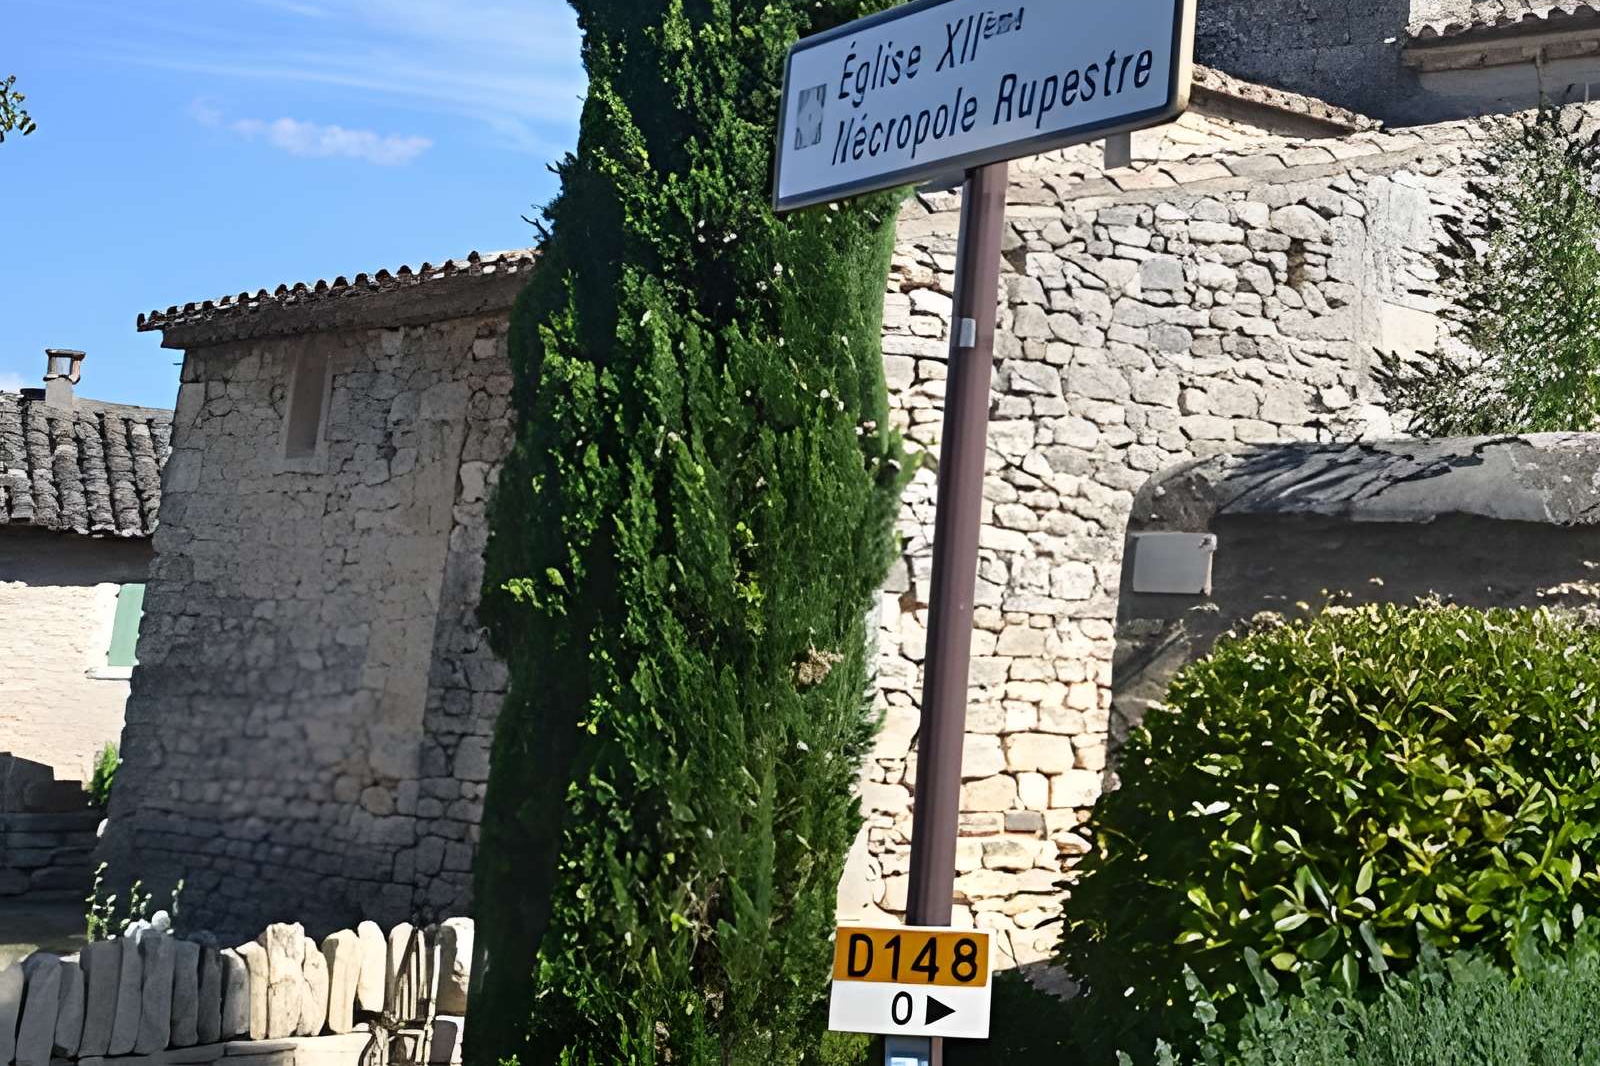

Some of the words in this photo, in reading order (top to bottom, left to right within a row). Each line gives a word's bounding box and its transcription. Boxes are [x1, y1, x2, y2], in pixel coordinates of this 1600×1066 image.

[838, 40, 922, 109] Église
[831, 86, 978, 166] Nécropole
[992, 49, 1153, 130] Rupestre
[847, 933, 978, 983] D148
[891, 990, 913, 1026] 0
